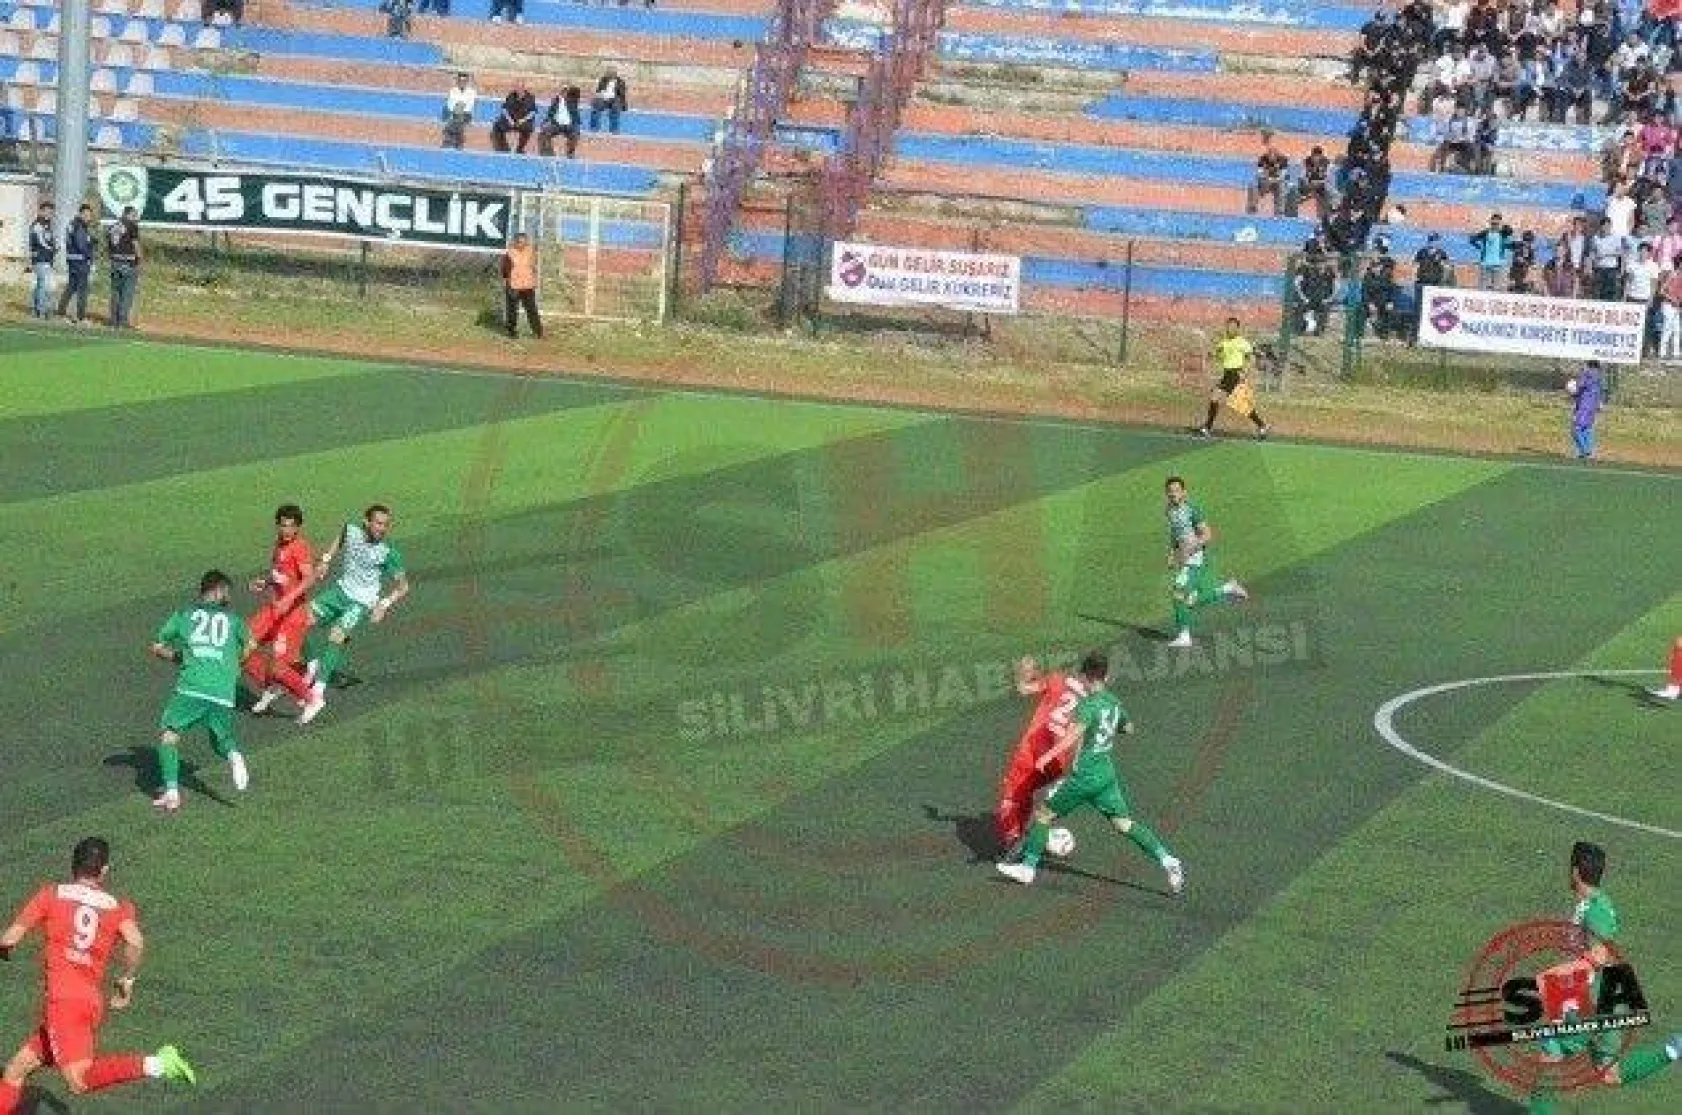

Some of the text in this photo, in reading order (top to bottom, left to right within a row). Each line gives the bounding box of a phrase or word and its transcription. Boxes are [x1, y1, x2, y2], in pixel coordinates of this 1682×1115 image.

[163, 176, 504, 241] 45 GENÇLİK
[189, 607, 231, 647] 20
[73, 905, 99, 950] 9
